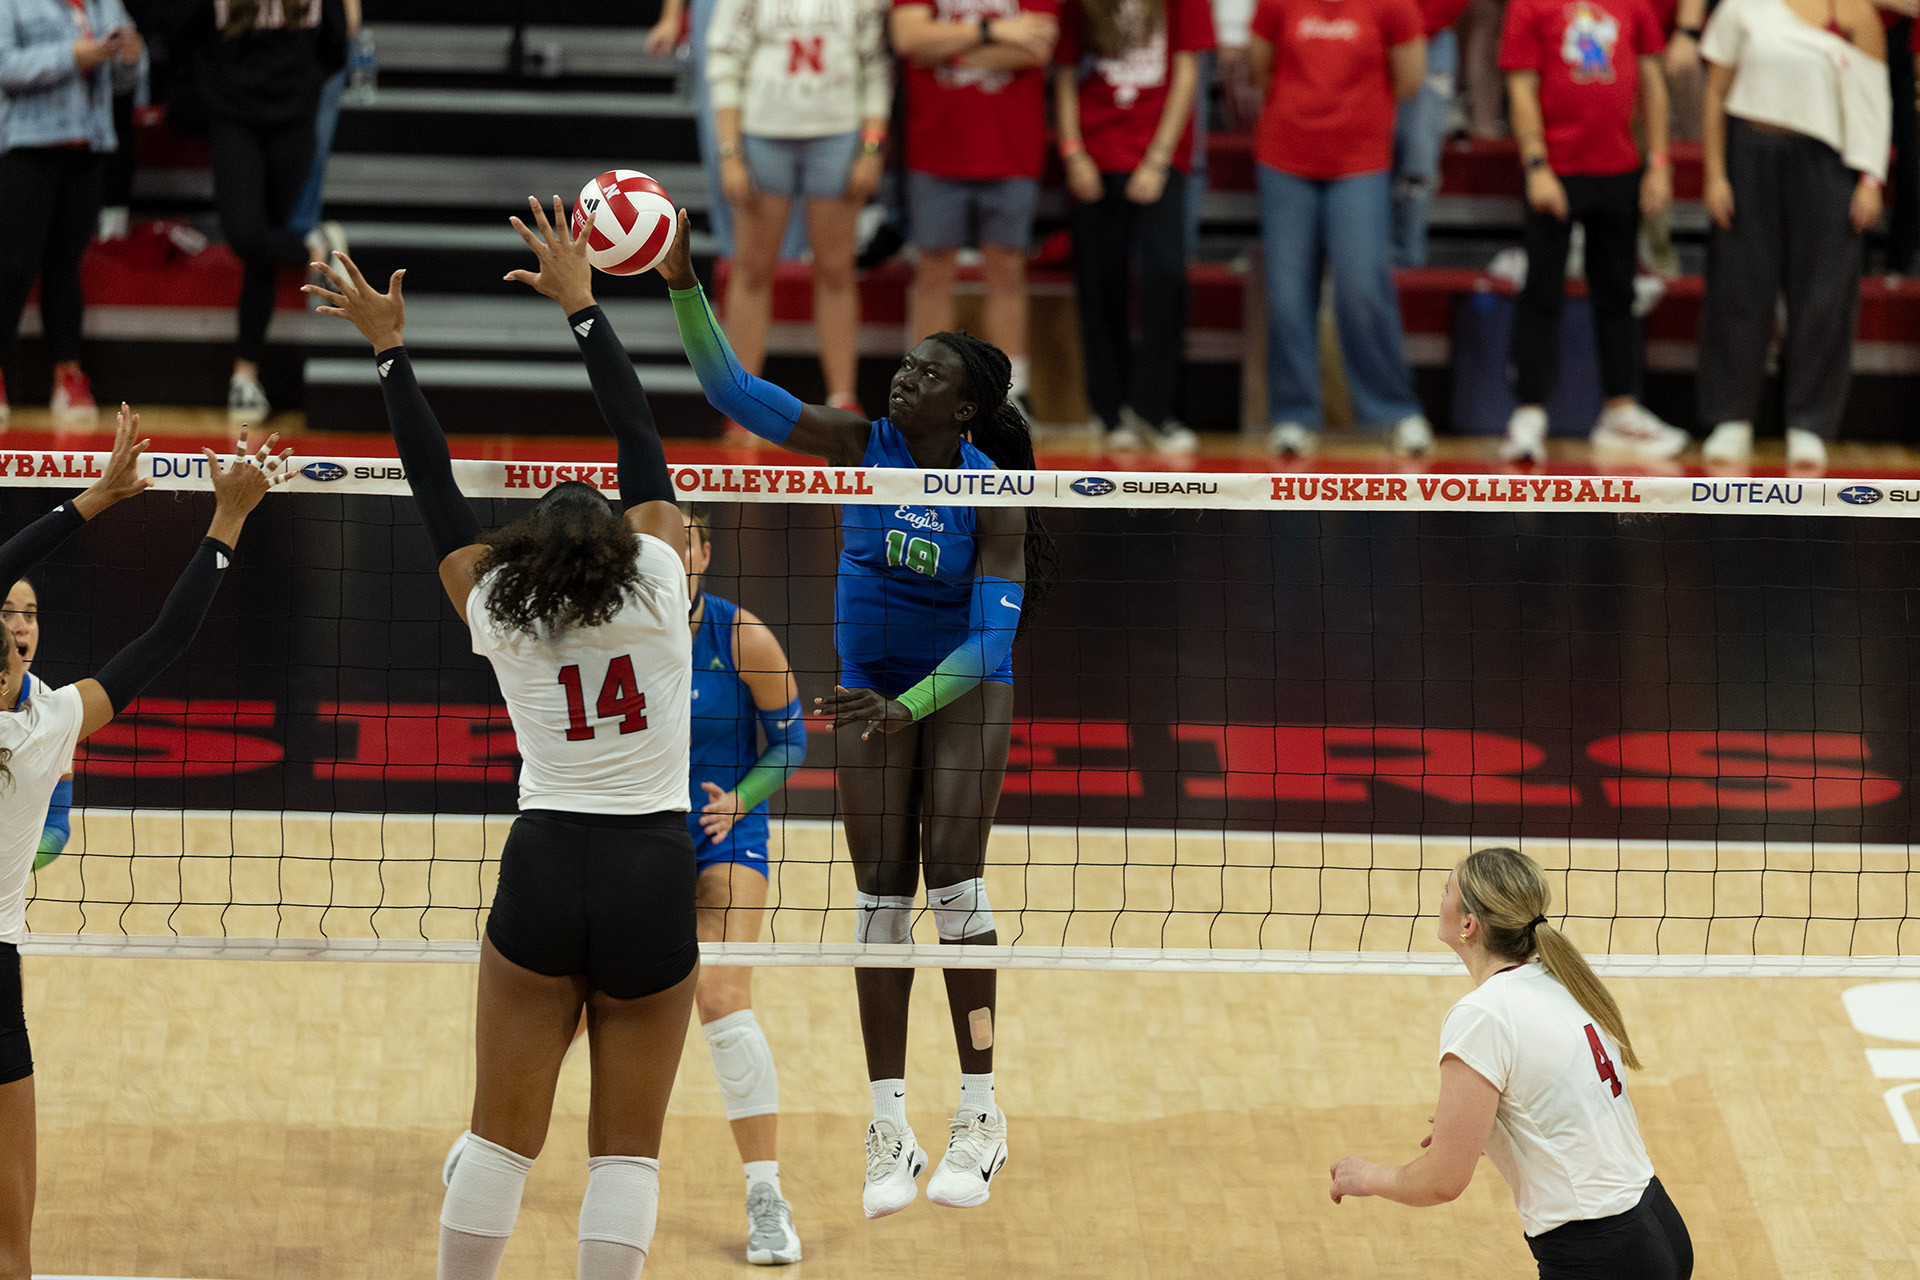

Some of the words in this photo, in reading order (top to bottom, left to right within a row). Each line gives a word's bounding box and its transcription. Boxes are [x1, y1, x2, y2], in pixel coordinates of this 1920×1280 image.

[786, 36, 824, 75] N
[603, 183, 621, 200] N
[354, 467, 408, 480] SUB
[504, 464, 620, 490] HUSKE
[666, 468, 873, 495] OLLEYBALL
[923, 474, 1035, 495] DUTEAU
[1122, 481, 1219, 494] SUBARU
[1270, 477, 1408, 501] HUSKER
[1417, 478, 1641, 503] VOLLEYBALL
[1692, 482, 1803, 504] DUTEAU
[894, 504, 945, 532] Eagles
[557, 653, 648, 742] 14
[1583, 1022, 1622, 1098] 4
